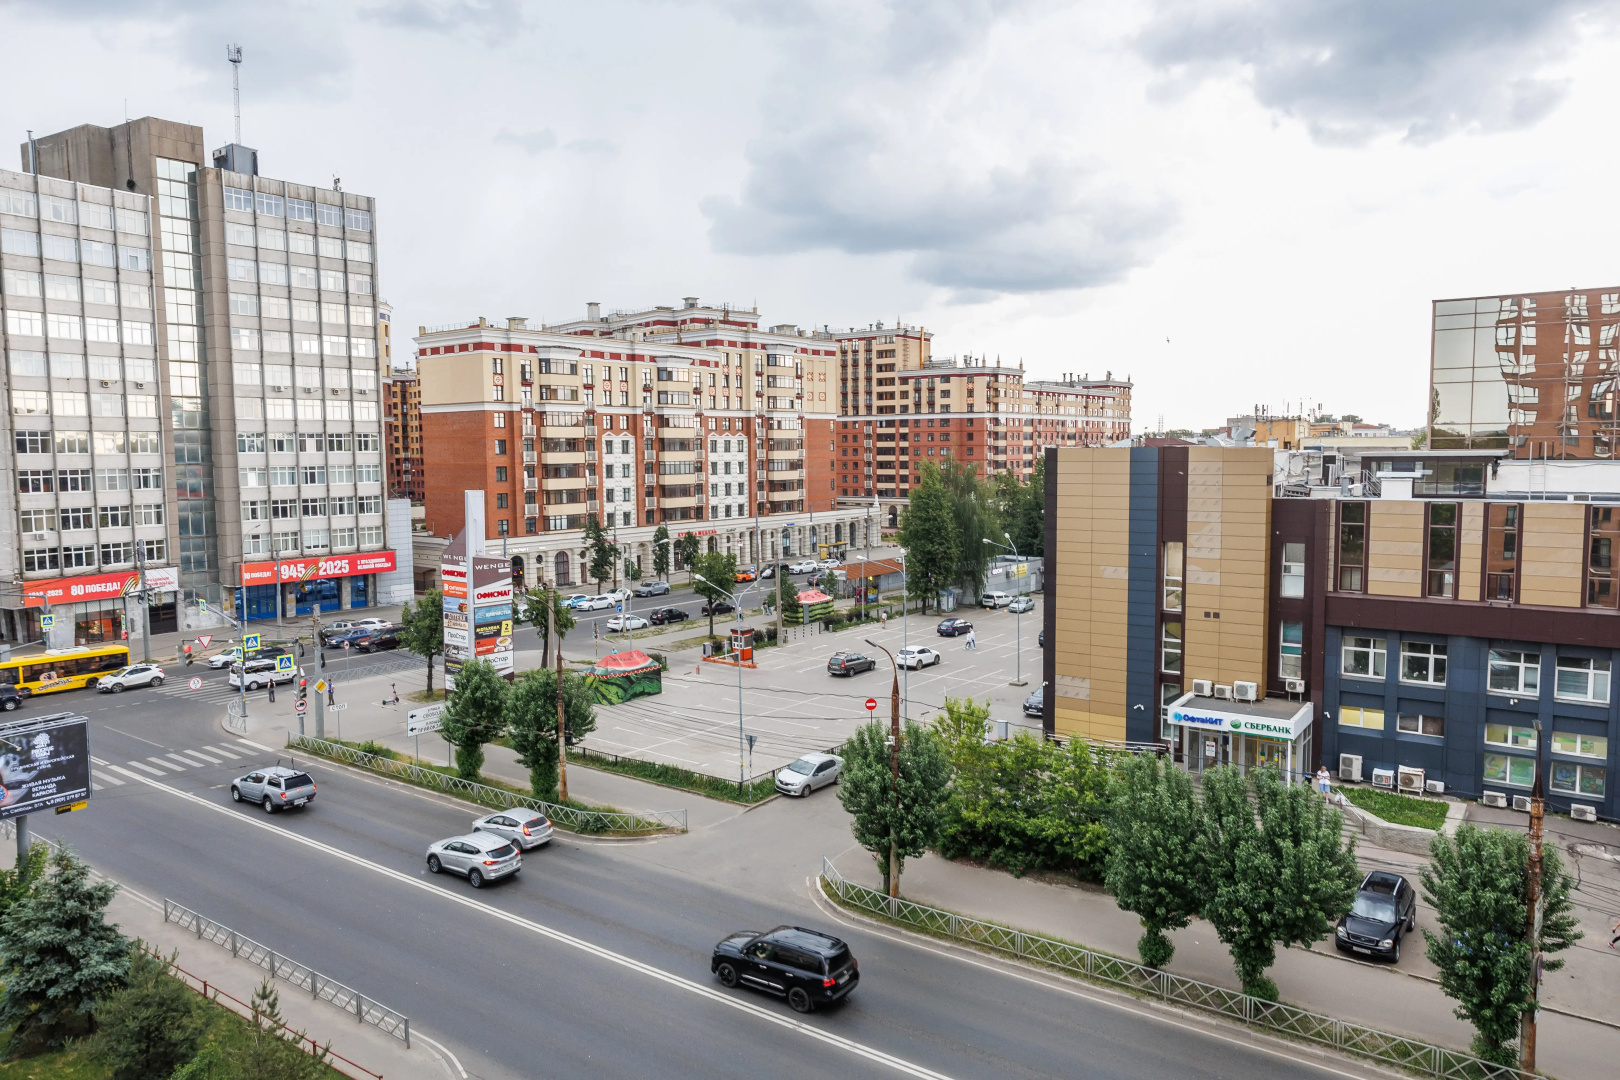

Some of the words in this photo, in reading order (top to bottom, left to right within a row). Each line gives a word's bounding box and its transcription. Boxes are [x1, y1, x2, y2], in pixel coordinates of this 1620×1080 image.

[318, 560, 349, 576] 2025
[475, 562, 511, 570] WENGE
[71, 584, 84, 596] 80
[85, 581, 121, 593] ПОБЕДА!
[476, 589, 511, 600] ОФИСМАГ
[1183, 714, 1223, 726] ОфтаКИТ
[1244, 721, 1291, 735] СБЕРБАНК
[21, 781, 42, 789] ЖИВАЯ
[43, 775, 66, 784] МУЗЫКА
[31, 788, 57, 797] КАРАОКЕ
